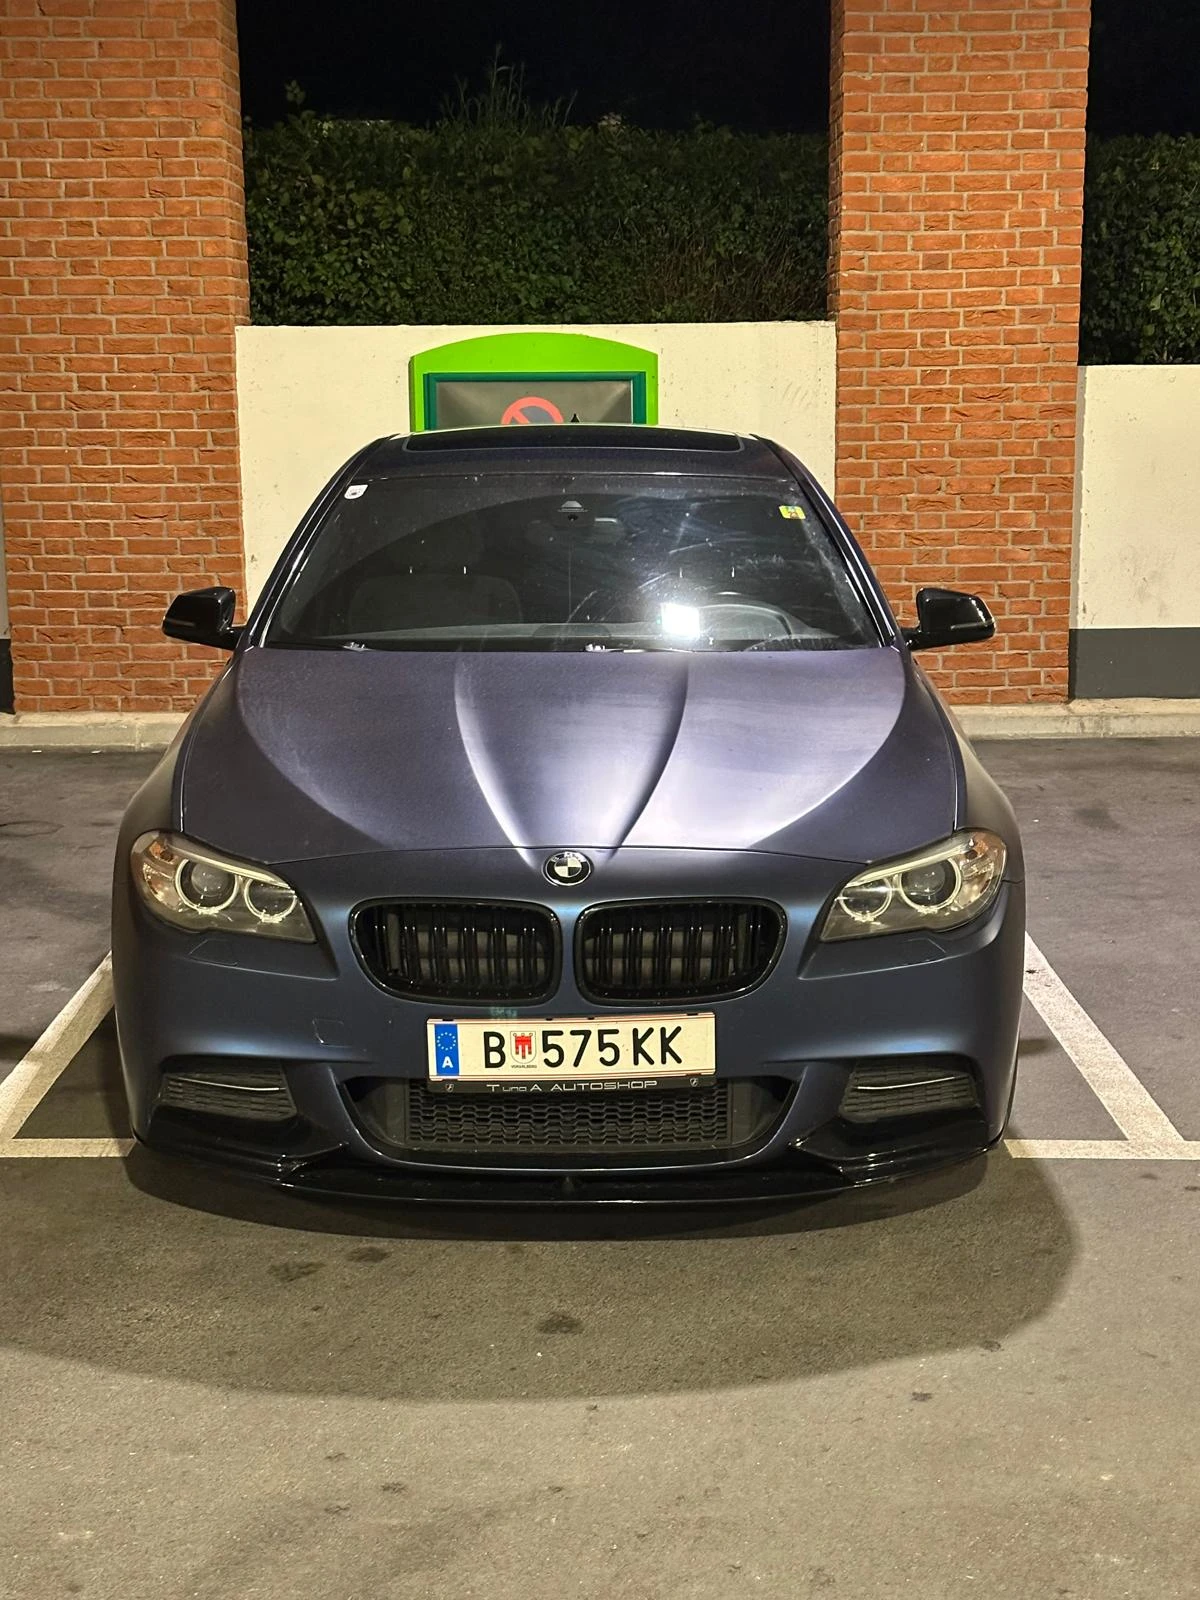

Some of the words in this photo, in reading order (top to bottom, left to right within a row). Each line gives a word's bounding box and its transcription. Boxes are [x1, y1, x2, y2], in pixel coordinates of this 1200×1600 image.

[483, 1031, 506, 1069] B
[441, 1056, 454, 1069] A
[550, 1080, 658, 1092] AUTOSHOP
